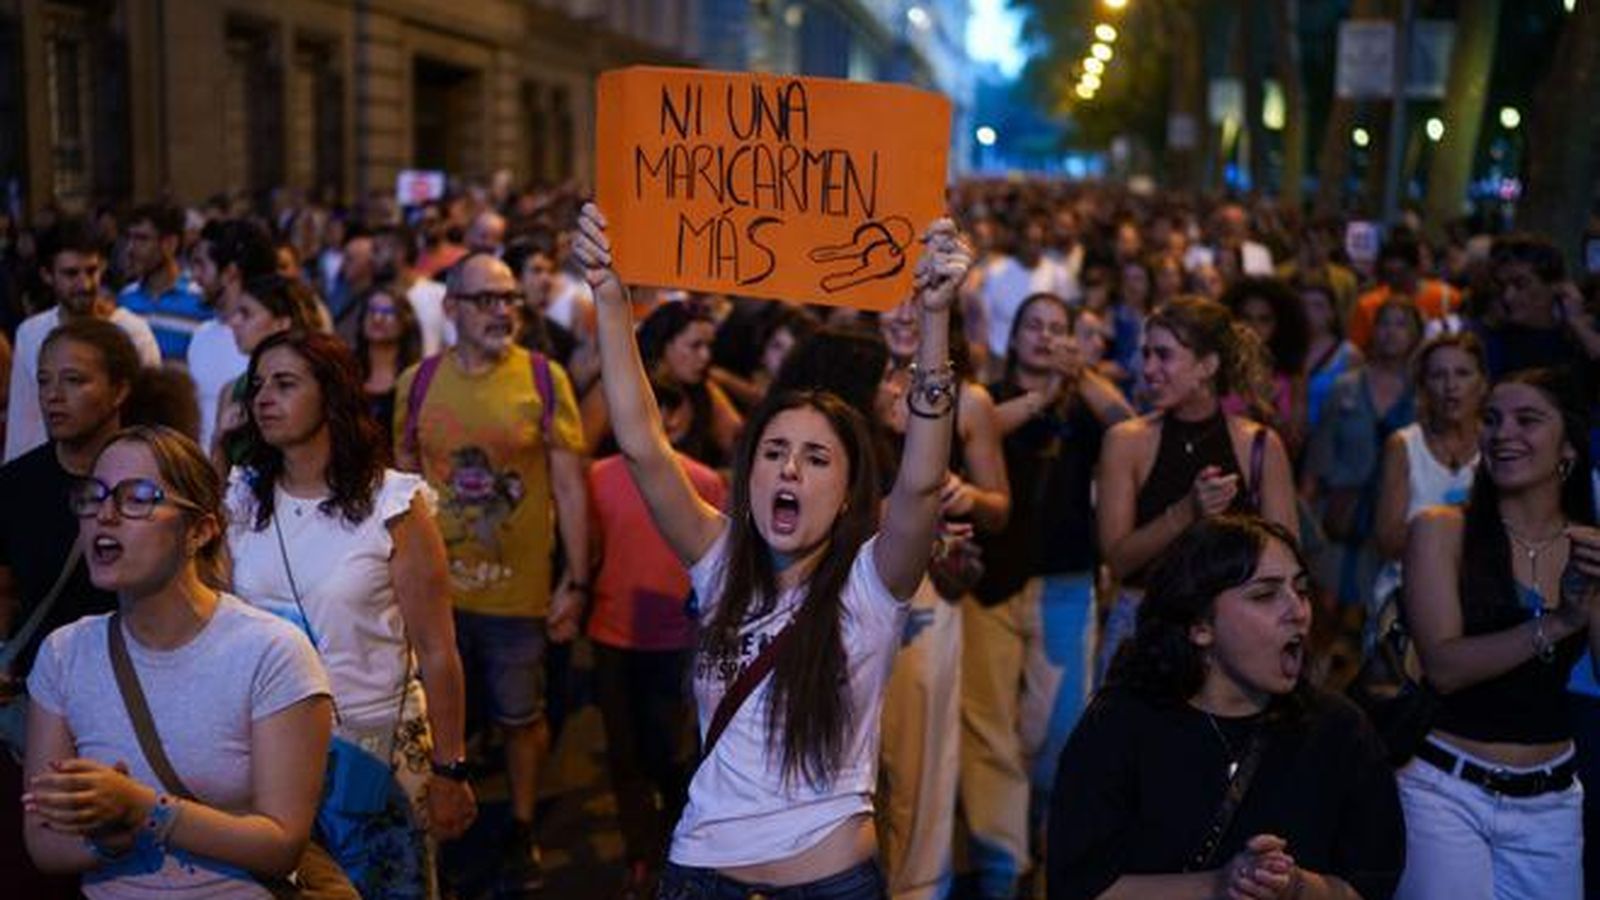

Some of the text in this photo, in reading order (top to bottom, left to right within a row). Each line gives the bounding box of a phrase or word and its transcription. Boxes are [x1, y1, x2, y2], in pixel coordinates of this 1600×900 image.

[660, 80, 808, 142] NI UNA
[634, 143, 877, 219] MARICARMEN
[677, 207, 784, 286] MÁS
